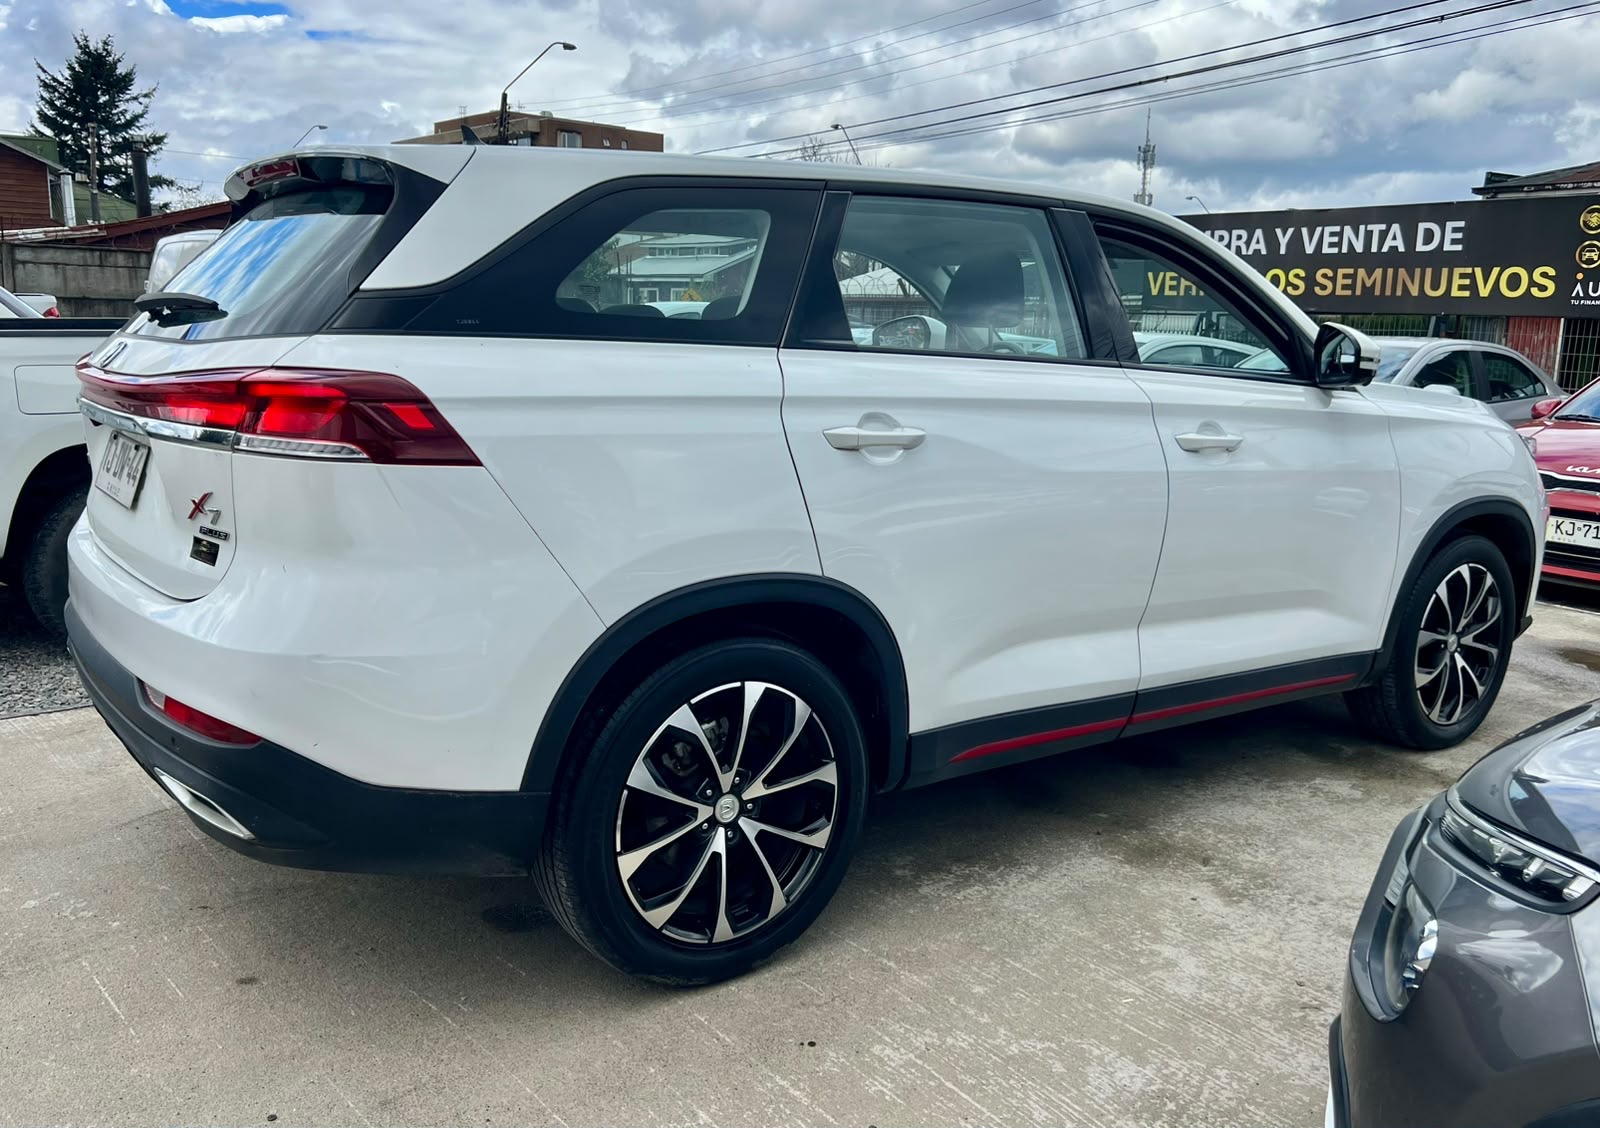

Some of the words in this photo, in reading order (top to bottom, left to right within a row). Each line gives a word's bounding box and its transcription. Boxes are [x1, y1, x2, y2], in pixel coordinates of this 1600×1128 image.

[1204, 228, 1267, 255] PRA
[1274, 227, 1295, 255] Y
[1301, 223, 1405, 254] VENTA
[1415, 220, 1466, 252] DE
[1314, 265, 1557, 298] SEMINUEVOS
[187, 491, 222, 526] X7
[201, 526, 227, 539] PLUS
